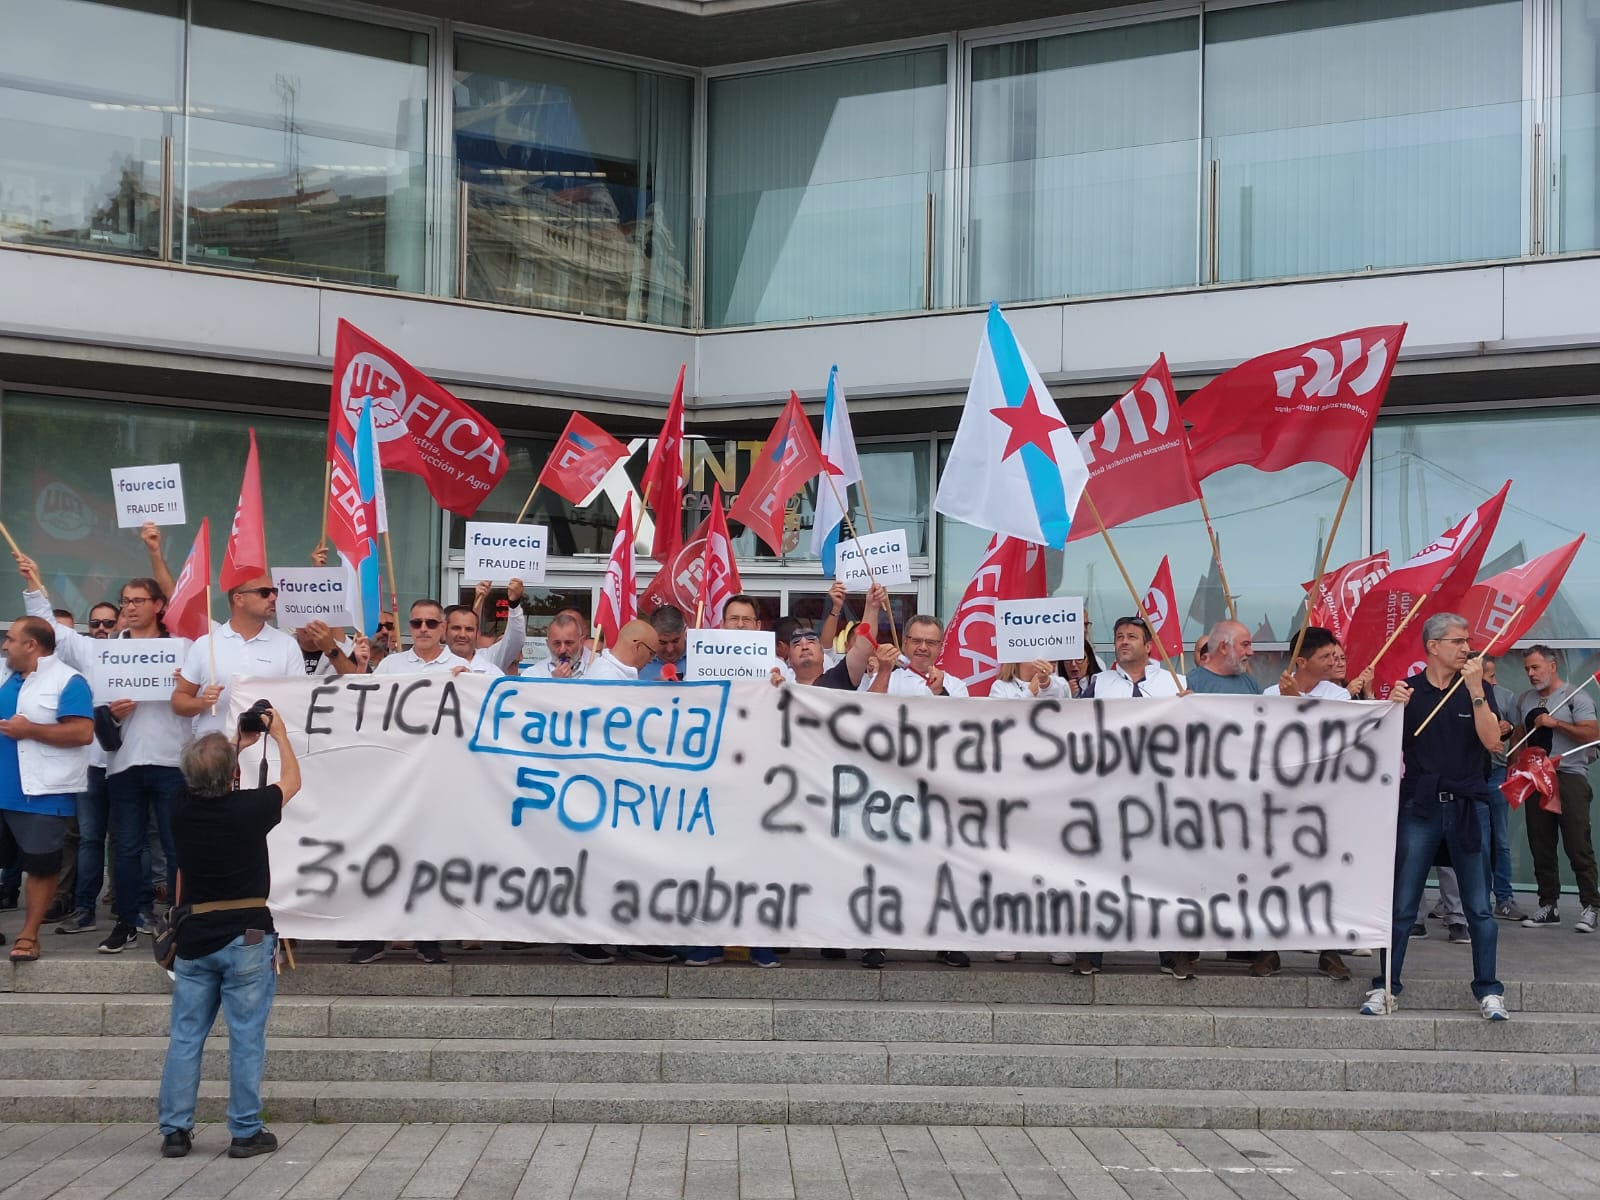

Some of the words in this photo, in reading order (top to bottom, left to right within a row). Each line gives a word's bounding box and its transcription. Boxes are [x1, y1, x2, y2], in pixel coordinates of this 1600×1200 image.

[400, 394, 500, 474] FICA
[120, 476, 176, 493] faurecia
[456, 470, 465, 480] y
[465, 474, 491, 490] Agro
[126, 502, 165, 514] FRAUDE
[474, 533, 541, 549] faurecia
[841, 541, 900, 562] faurecia
[478, 558, 526, 570] FRAUDE
[529, 561, 539, 570] !!!
[280, 578, 343, 593] faurecia
[285, 603, 330, 614] SOLUCIÓN
[1004, 609, 1076, 626] faurecia
[695, 641, 768, 655] faurecia
[1008, 634, 1063, 647] SOLUCIÓN
[1066, 636, 1075, 645] !!!
[102, 650, 176, 665] faurecia
[698, 666, 753, 677] SOLUCIÓN
[756, 668, 766, 677] !!!
[108, 677, 160, 688] FRAUDE
[306, 675, 466, 738] ÉTICA
[492, 689, 713, 758] faurecia
[777, 687, 1016, 775] 1-Cobrar
[1022, 697, 1393, 787] Subvencións.
[511, 766, 716, 836] FORVIA
[759, 763, 1030, 852] 2-Pechar
[1060, 803, 1101, 856] a
[1117, 780, 1355, 866] planta.
[403, 848, 589, 914] persoal
[847, 863, 904, 937] da
[926, 859, 1362, 945] Administración.
